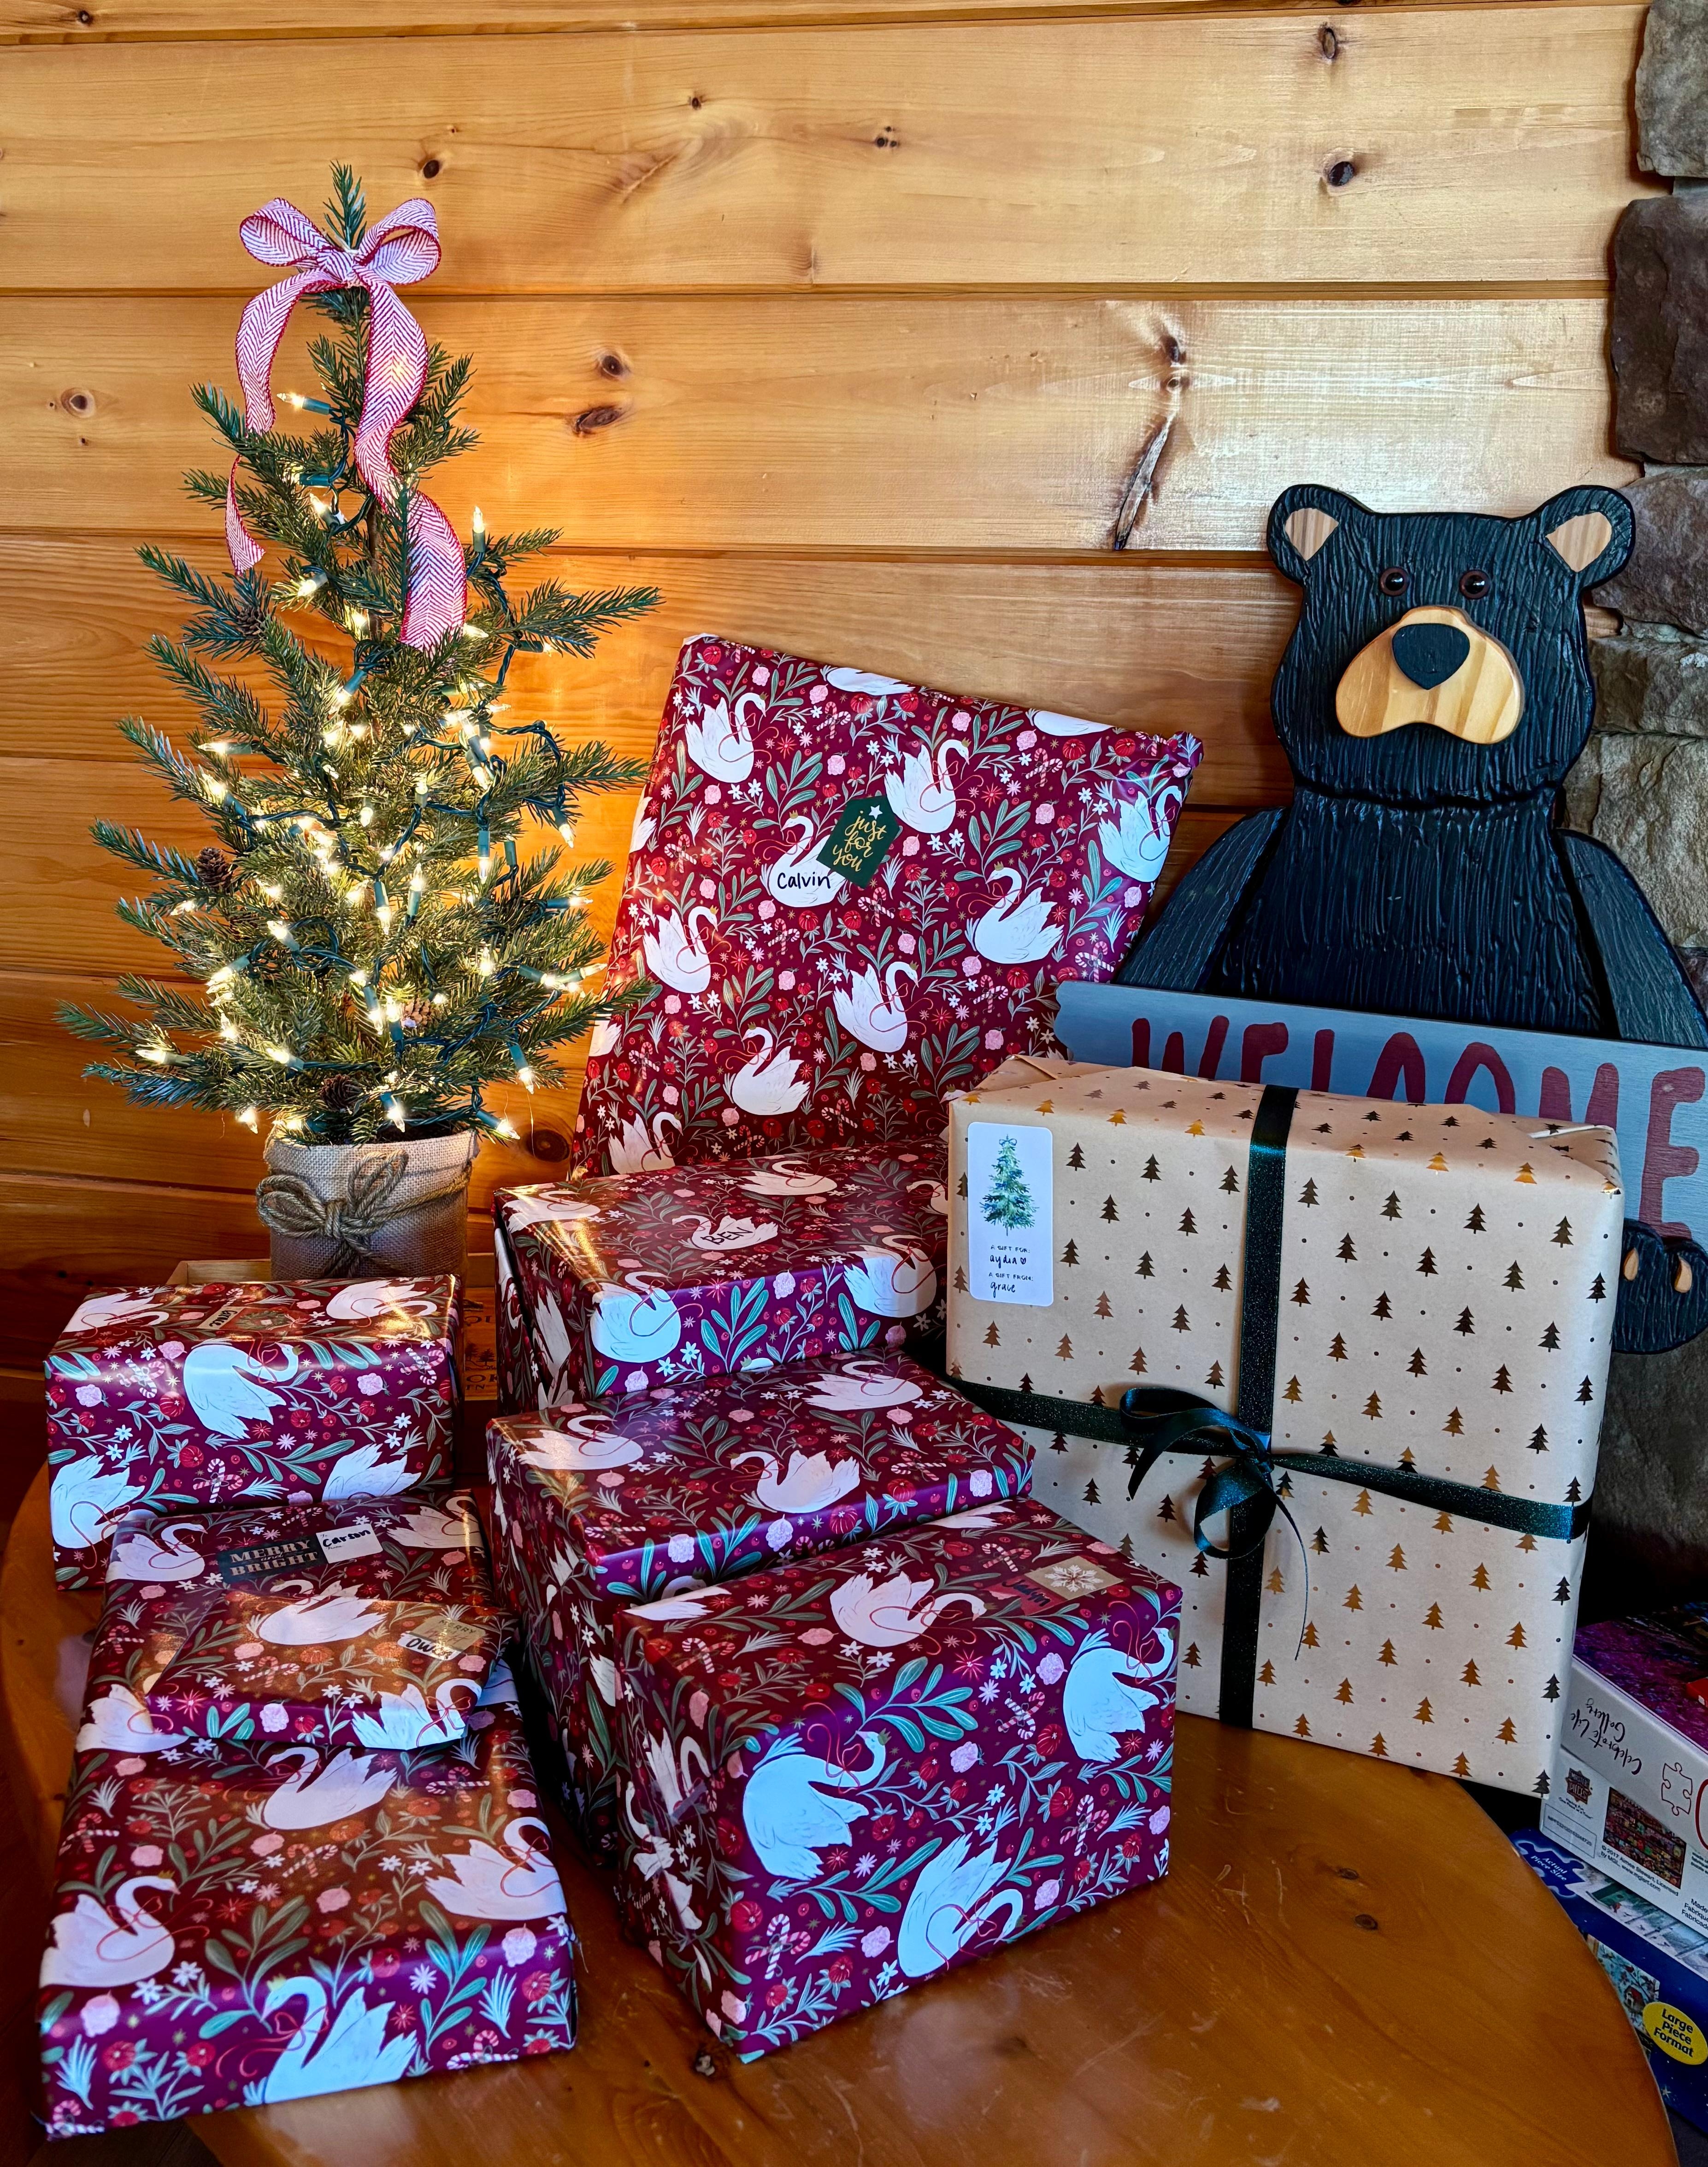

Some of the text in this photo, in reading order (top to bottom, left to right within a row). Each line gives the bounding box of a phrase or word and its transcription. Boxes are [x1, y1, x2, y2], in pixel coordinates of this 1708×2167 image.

[845, 810, 887, 840] just
[844, 831, 873, 857] for
[832, 844, 863, 872] you
[777, 872, 831, 890] Calvin
[700, 1227, 754, 1245] BEN
[990, 1281, 1016, 1299] grace
[323, 1528, 371, 1547] Carson
[230, 1540, 311, 1563] MERRY
[230, 1552, 318, 1576] BRIGHT
[1585, 1698, 1625, 1743] Gallery
[1570, 1708, 1642, 1775] Celebrate Life
[1542, 1858, 1567, 1873] Actual
[1661, 2008, 1694, 2034] Large
[1661, 2021, 1692, 2045] Piece
[1654, 2026, 1694, 2058] Format
